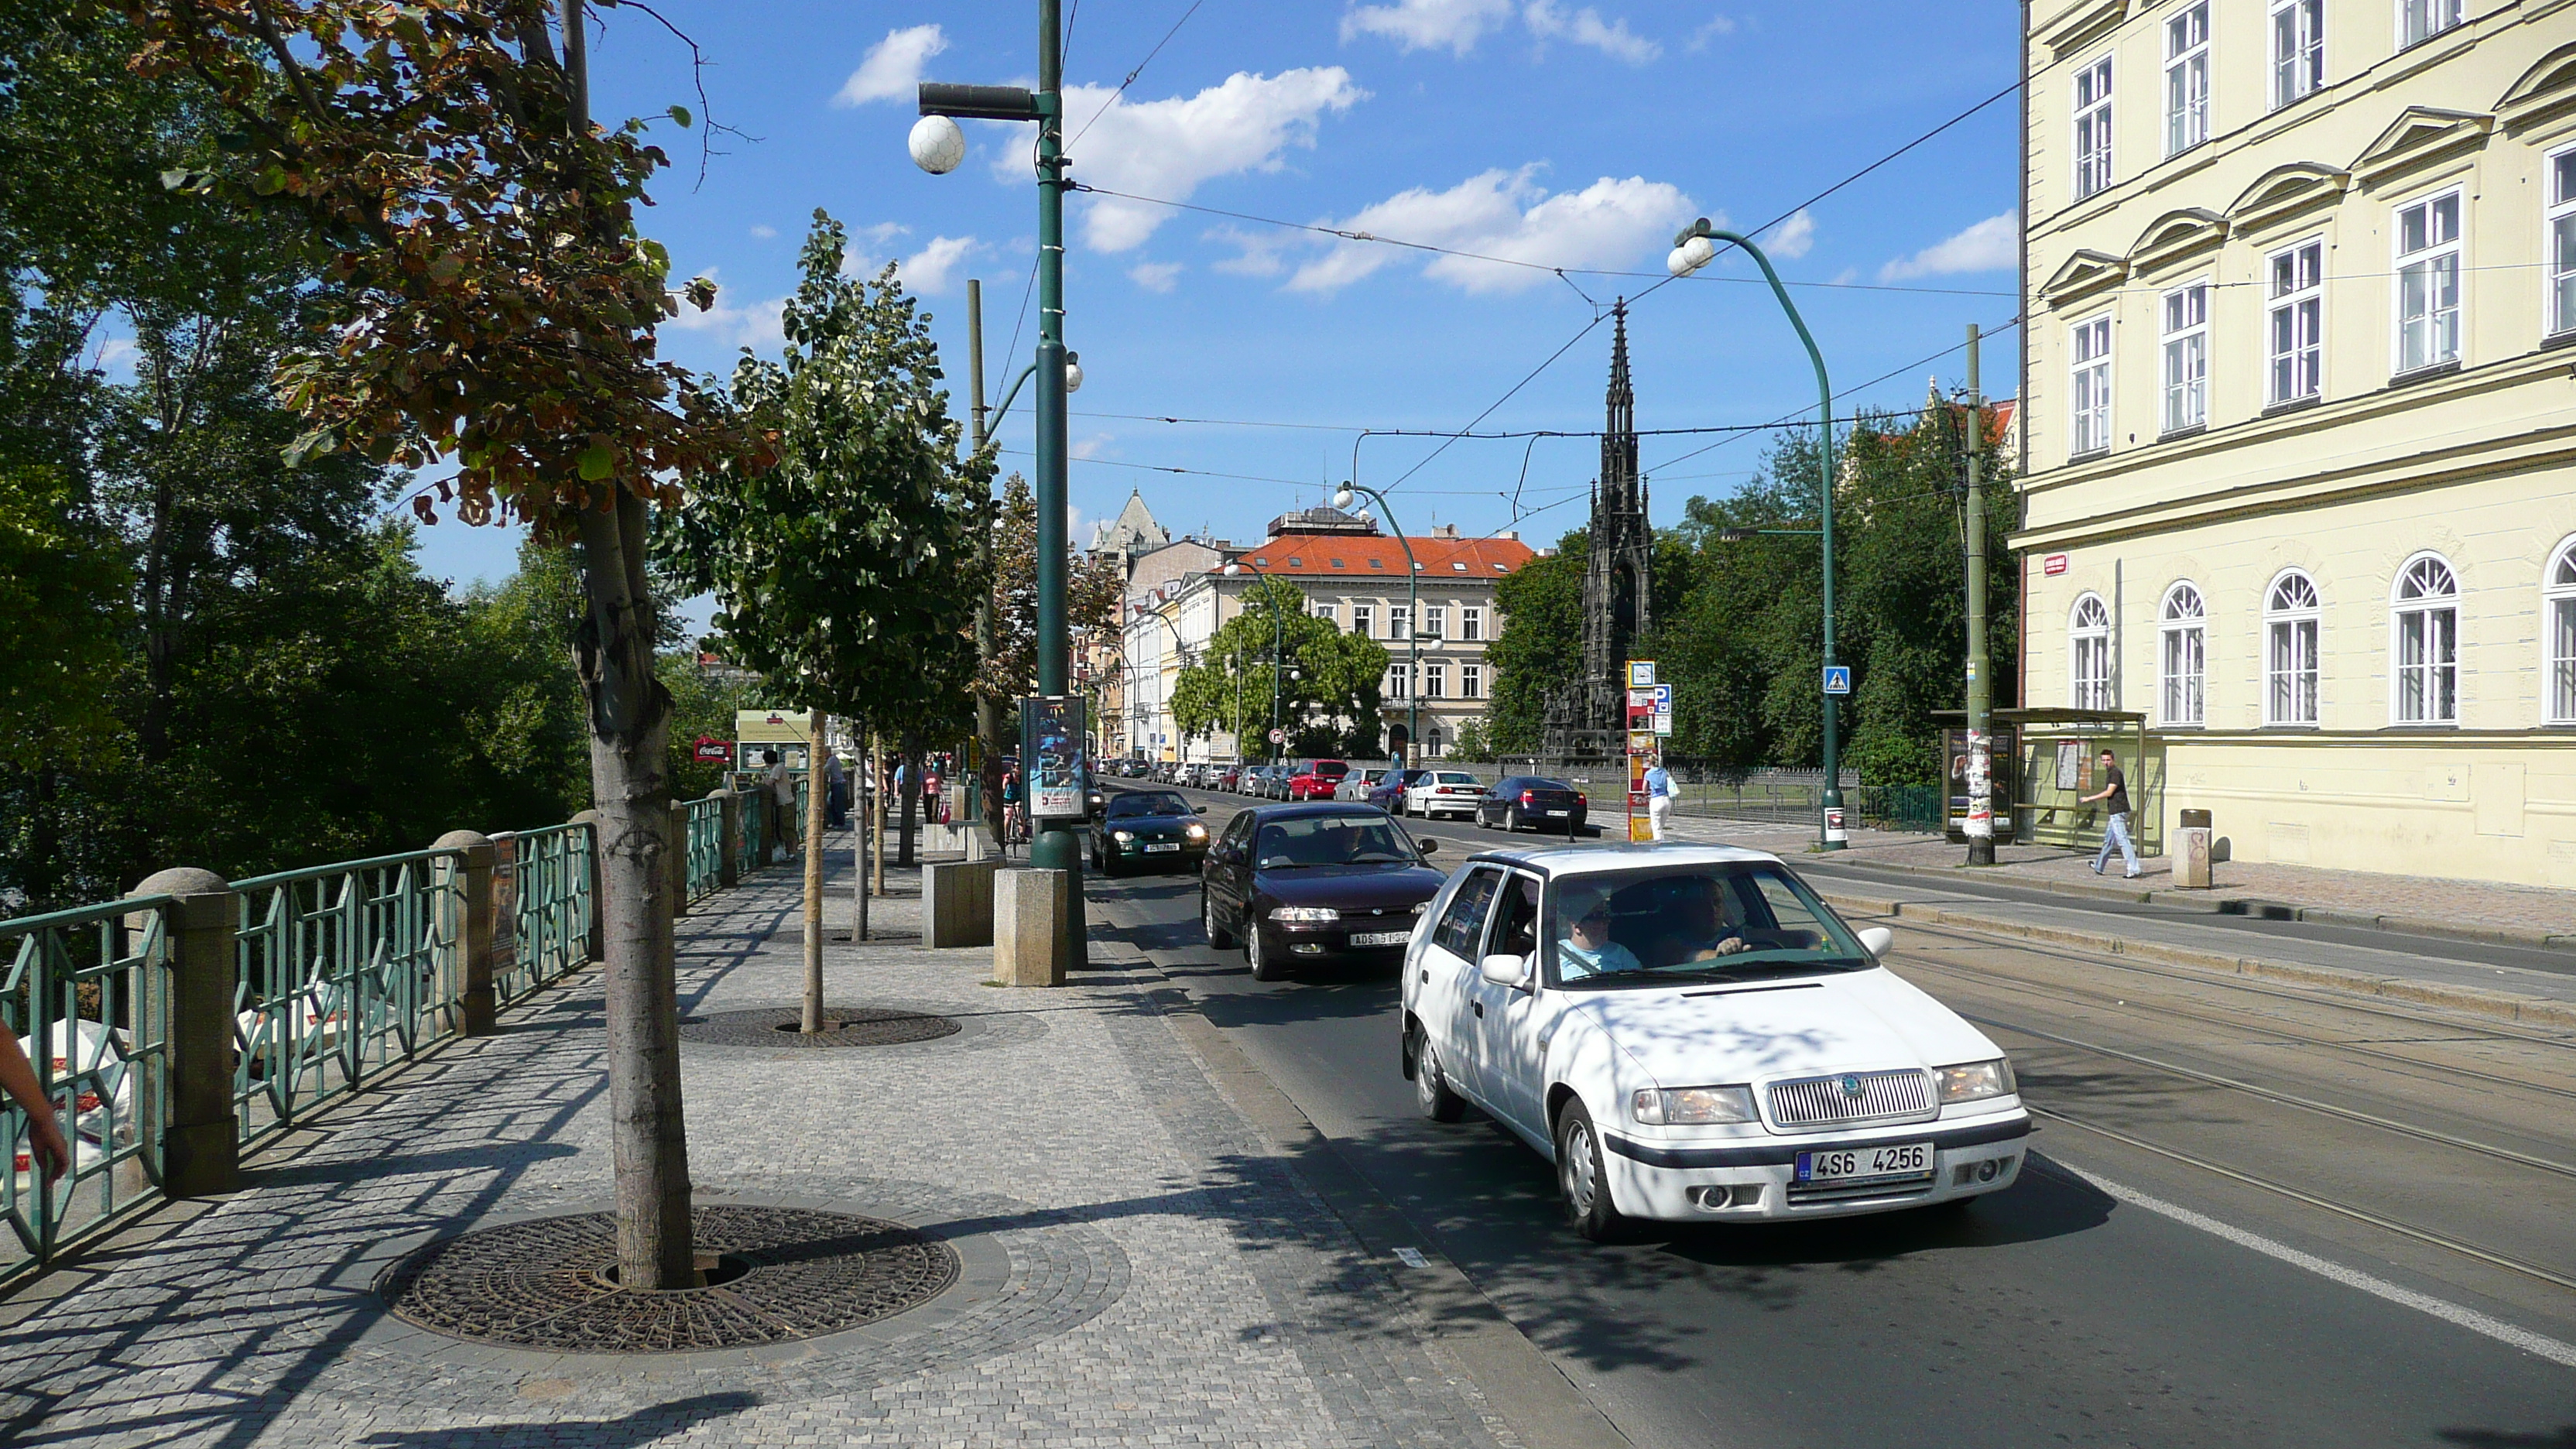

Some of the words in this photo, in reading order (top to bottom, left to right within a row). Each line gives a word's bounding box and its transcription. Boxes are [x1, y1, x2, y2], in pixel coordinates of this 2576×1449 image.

[1655, 687, 1667, 705] P
[1355, 934, 1374, 944] ADS
[1817, 1153, 1855, 1176] 4S6
[1872, 1146, 1923, 1171] 4256
